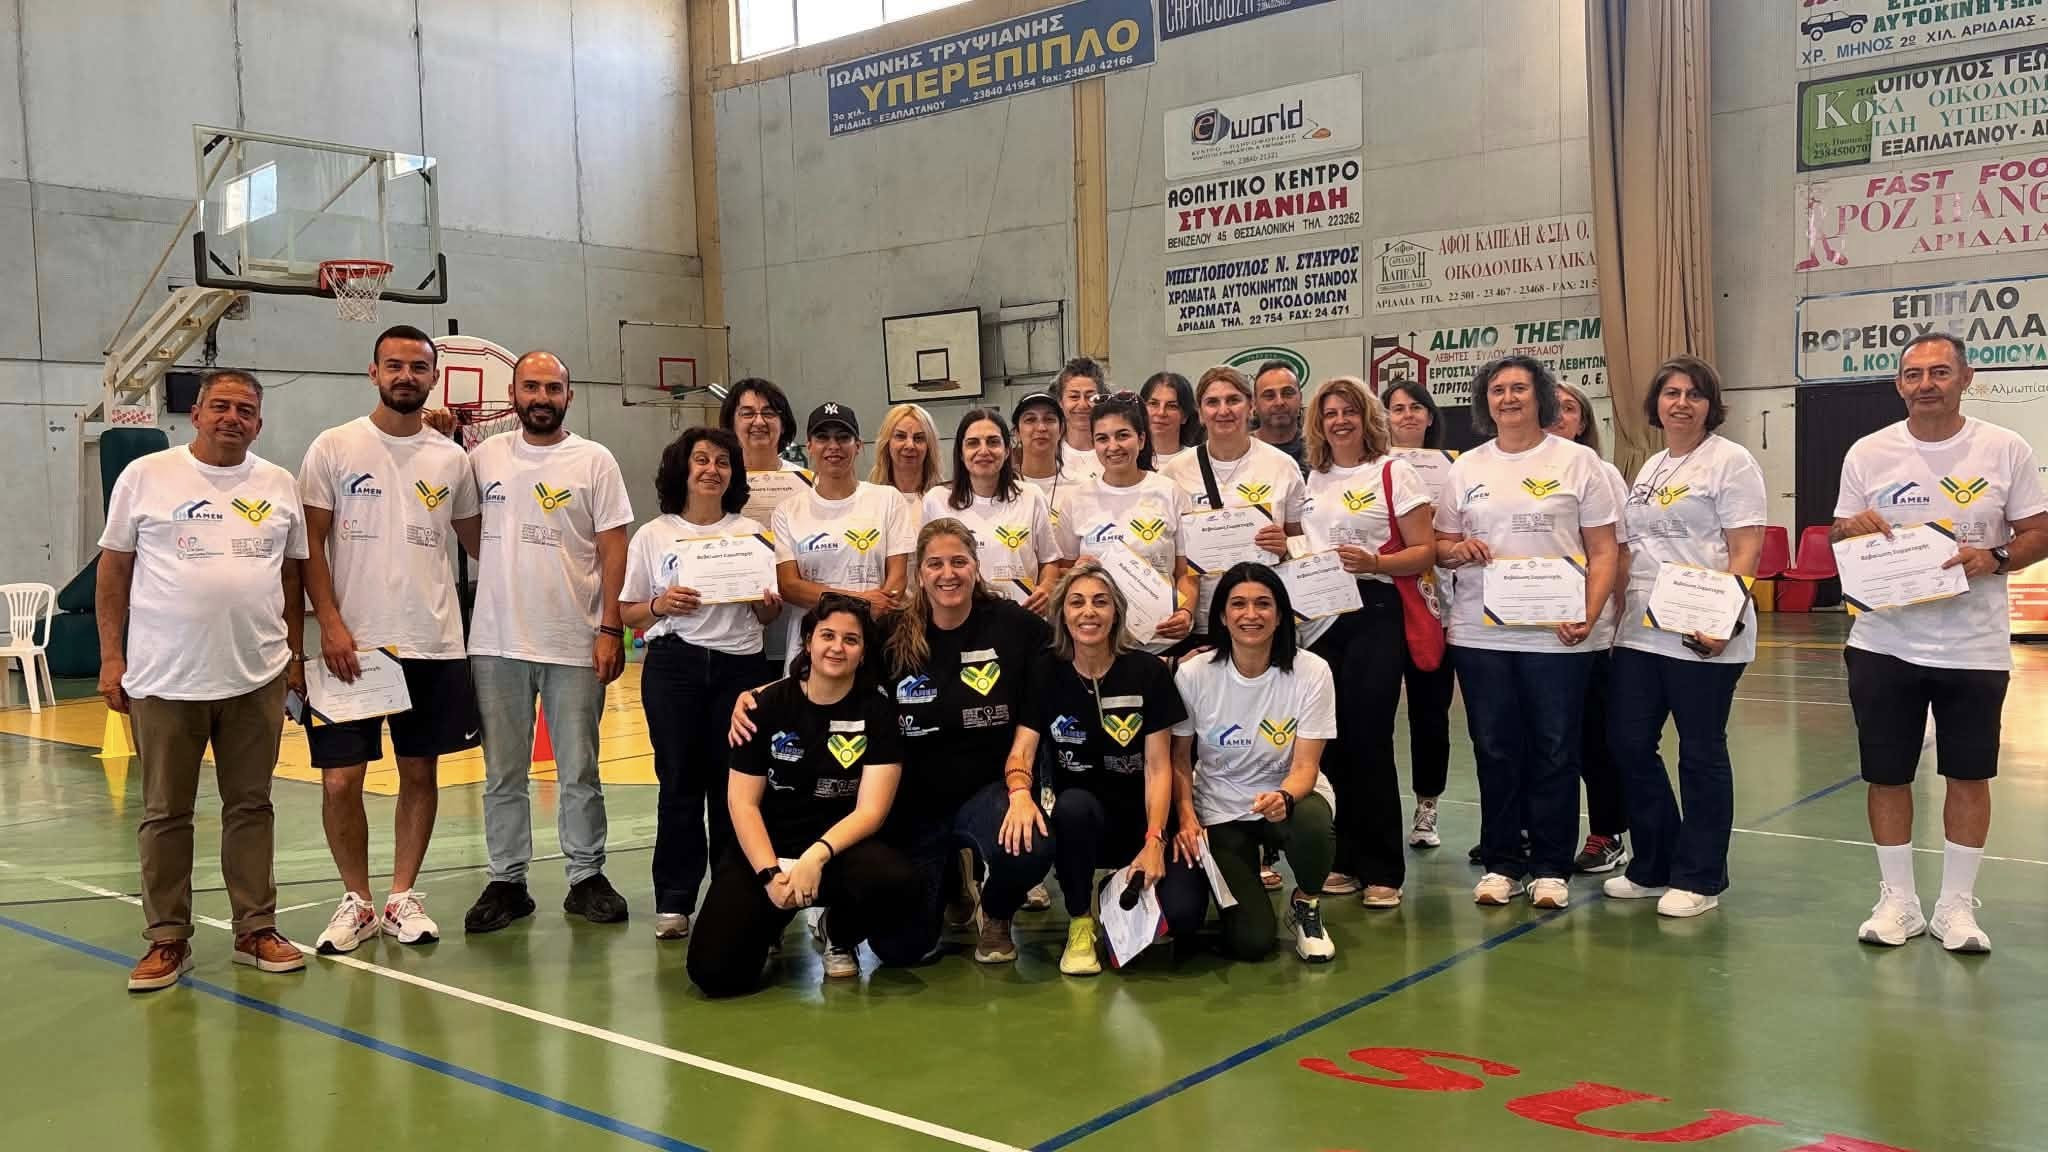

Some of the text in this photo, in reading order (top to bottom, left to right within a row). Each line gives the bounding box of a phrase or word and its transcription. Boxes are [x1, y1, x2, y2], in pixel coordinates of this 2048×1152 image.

[830, 14, 1064, 88] ΙΩΑΝΝΗΣ ΤΡΥΨΙΑΝΗΣ
[1802, 49, 1827, 65] ΧΡ.
[1837, 36, 1894, 58] ΜΗΝΟΣ
[1926, 29, 1956, 43] ΧΙΛ.
[1961, 14, 2036, 37] ΑΡΙΔΑΙΑΣ
[860, 19, 1140, 112] ΥΠΕΡΕΠΙΠΛΟ
[833, 117, 873, 134] ΑΡΙΔΑΙΑΣ
[879, 101, 946, 122] ΕΞΑΠΛΑΤΑΝΟΥ
[973, 86, 1003, 101] 23840
[1005, 77, 1036, 93] 41954
[1041, 72, 1062, 84] fax:
[1064, 63, 1096, 79] 23840
[1099, 54, 1133, 70] 42166
[1881, 123, 2018, 157] ΕΞΑΠΛΑΤΑΝΟΥ
[1275, 160, 1360, 192] ΚΕΝΤΡΟ
[1866, 157, 2048, 198] FAST FOO
[1178, 186, 1348, 232] ΣΤΥΛΙΑΝΙΔΗ
[1836, 197, 1919, 236] ΡΟΖ
[1167, 233, 1212, 249] ΒΕΝΙΖΕΛΟΥ
[1217, 230, 1227, 242] 45
[1234, 221, 1295, 240] ΘΕΣΣΑΛΟΝΙΚΗ
[1327, 211, 1360, 227] 223262
[1438, 233, 1470, 256] ΑΦΟΙ
[1476, 224, 1530, 251] ΚΑΠΕΛΗ
[1911, 222, 2048, 253] ΑΡΙΔΑΙΑ
[1165, 246, 1360, 287] ΜΠΕΓΛΟΠΟΥΛΟΣ Ν. ΣΤΑΥΡΟΣ
[1444, 250, 1598, 281] ΟΙΚΟΔΟΜΙΚΑ ΥΛΙΚΑ
[1168, 286, 1217, 306] ΧΡΩΜΑΤΑ
[1222, 276, 1298, 300] ΑΥΤΟΚΙΝΗΤΩΝ
[1304, 268, 1358, 290] STANDOX
[1448, 291, 1460, 301] 22
[1461, 290, 1475, 299] 501
[1483, 288, 1494, 298] 23
[1496, 287, 1511, 296] 467
[1519, 284, 1545, 294] 23468
[1579, 279, 1589, 289] 21
[1892, 286, 2020, 319] ΕΠΙΠΛΟ
[1179, 289, 1347, 320] ΧΡΩΜΑΤΑ ΟΙΚΟΔΟΜΩΝ
[1222, 316, 1244, 328] ΤΗΛ.
[1249, 315, 1262, 324] 22
[1264, 312, 1283, 323] 754
[1289, 309, 1312, 321] FAX:
[1315, 307, 1328, 318] 24
[1330, 305, 1350, 316] 471
[1430, 317, 1602, 351] ALMO THERM
[1802, 321, 1935, 353] ΒΟΡΕΙΟΥ
[1435, 351, 1469, 363] ΛΕΒΗΤΕΣ
[1512, 344, 1565, 357] ΠΕΤΡΕΛΑΙΟΥ
[1559, 356, 1607, 371] ΛΕΒΗΤΩΝ
[1595, 372, 1604, 385] Ε.
[356, 487, 382, 495] AMEN
[1899, 496, 1930, 504] AMEN
[195, 512, 223, 520] AMEN
[1226, 738, 1252, 746] AMEN
[1298, 1047, 1925, 1152] SU
